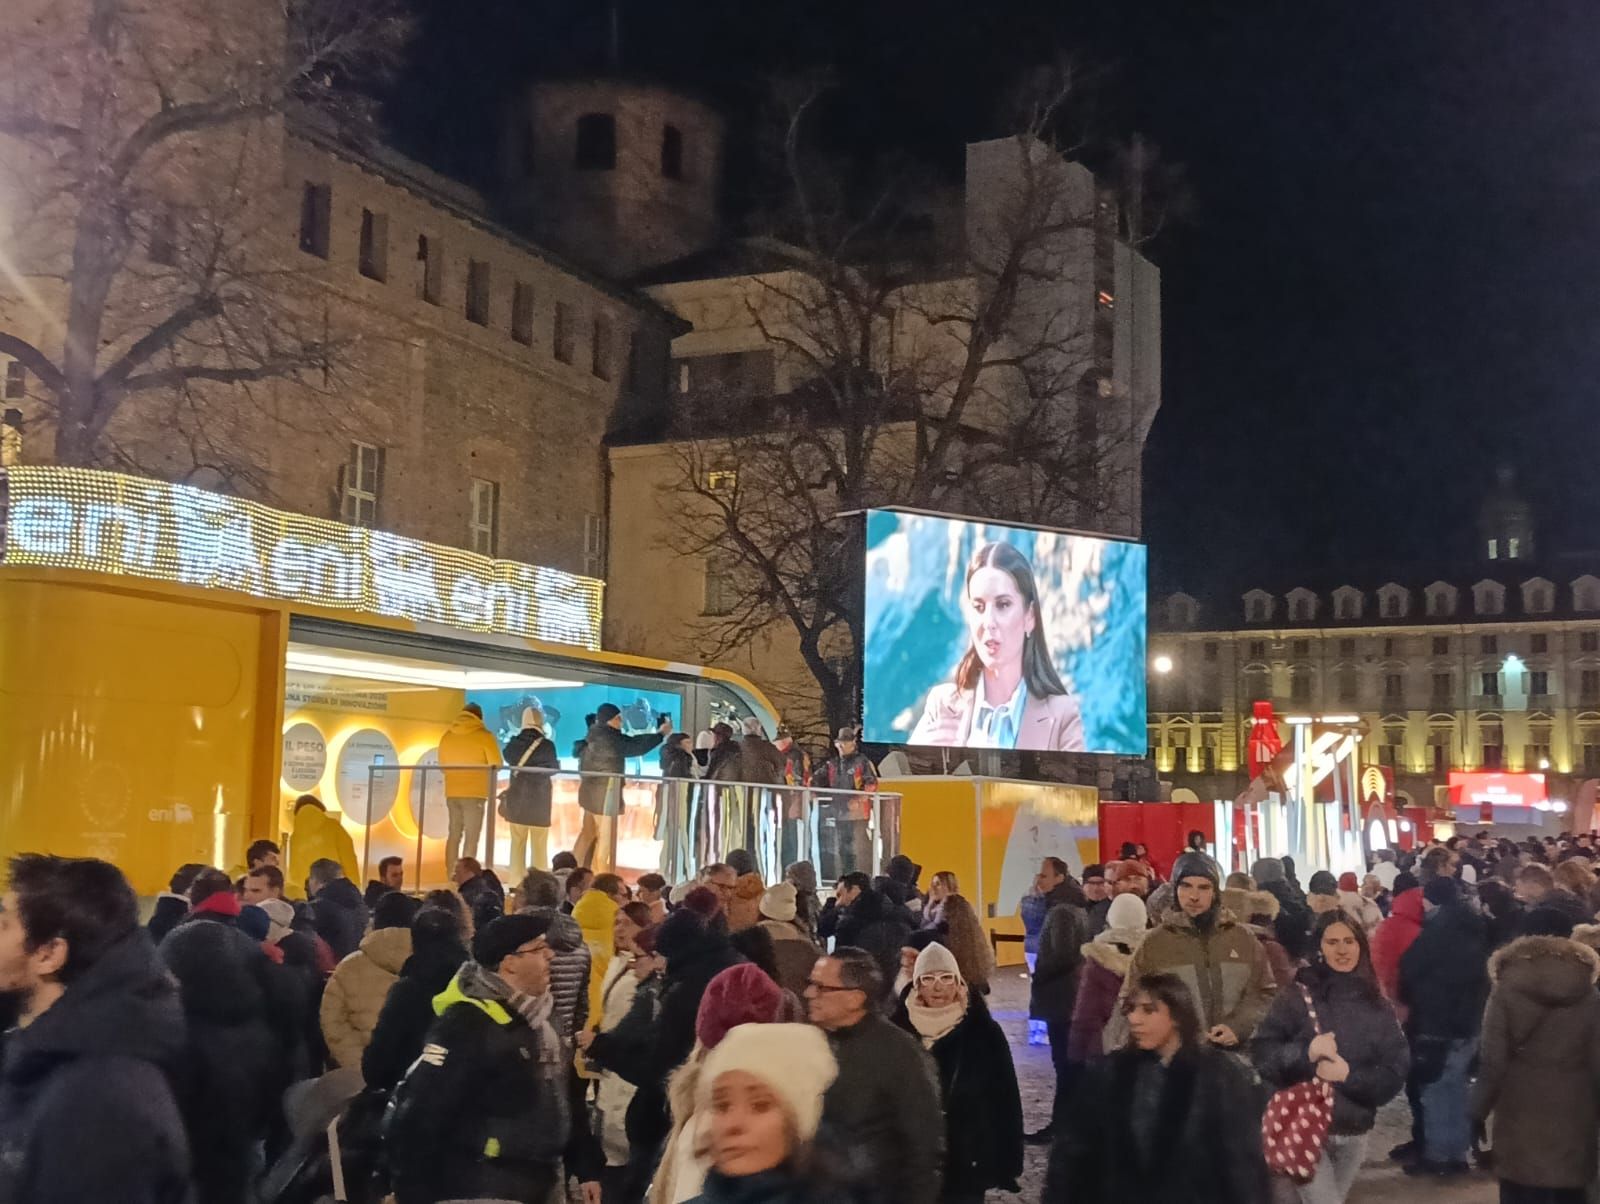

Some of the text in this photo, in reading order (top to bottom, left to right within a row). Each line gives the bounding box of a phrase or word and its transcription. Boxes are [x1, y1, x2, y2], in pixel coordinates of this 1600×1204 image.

[11, 490, 530, 634] eni eni eni
[297, 741, 323, 752] PESO
[148, 805, 173, 821] eni
